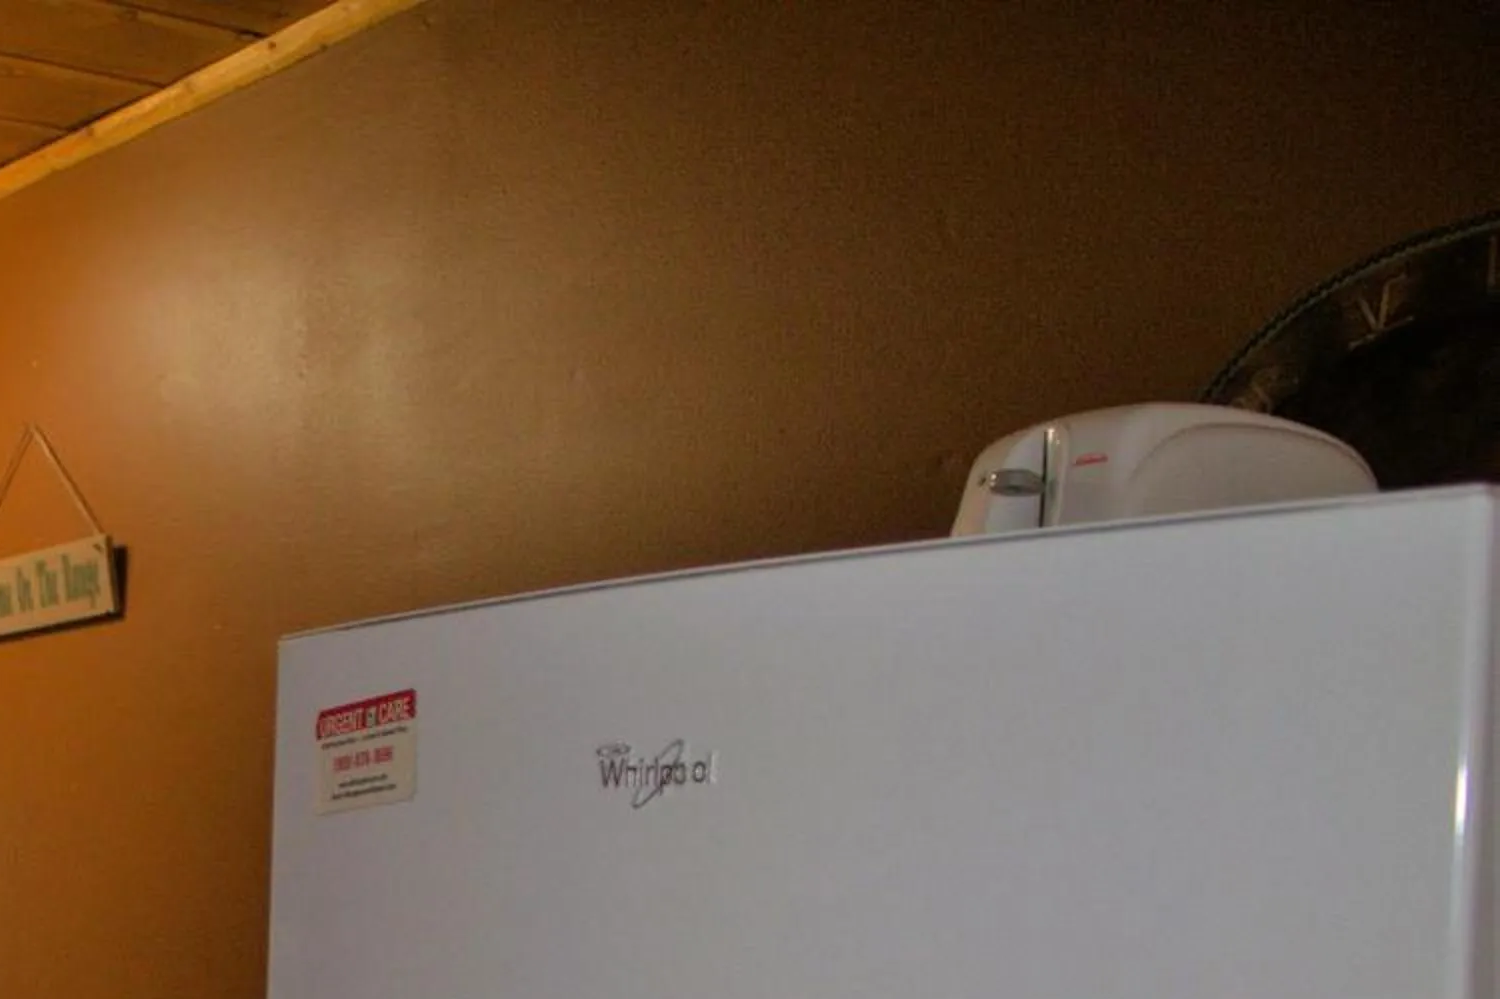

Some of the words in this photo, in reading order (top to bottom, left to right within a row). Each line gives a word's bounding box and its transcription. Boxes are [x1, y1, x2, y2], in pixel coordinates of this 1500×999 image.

[319, 706, 366, 738] URGENT
[378, 696, 413, 725] CARE
[598, 750, 717, 797] Whirlpool
